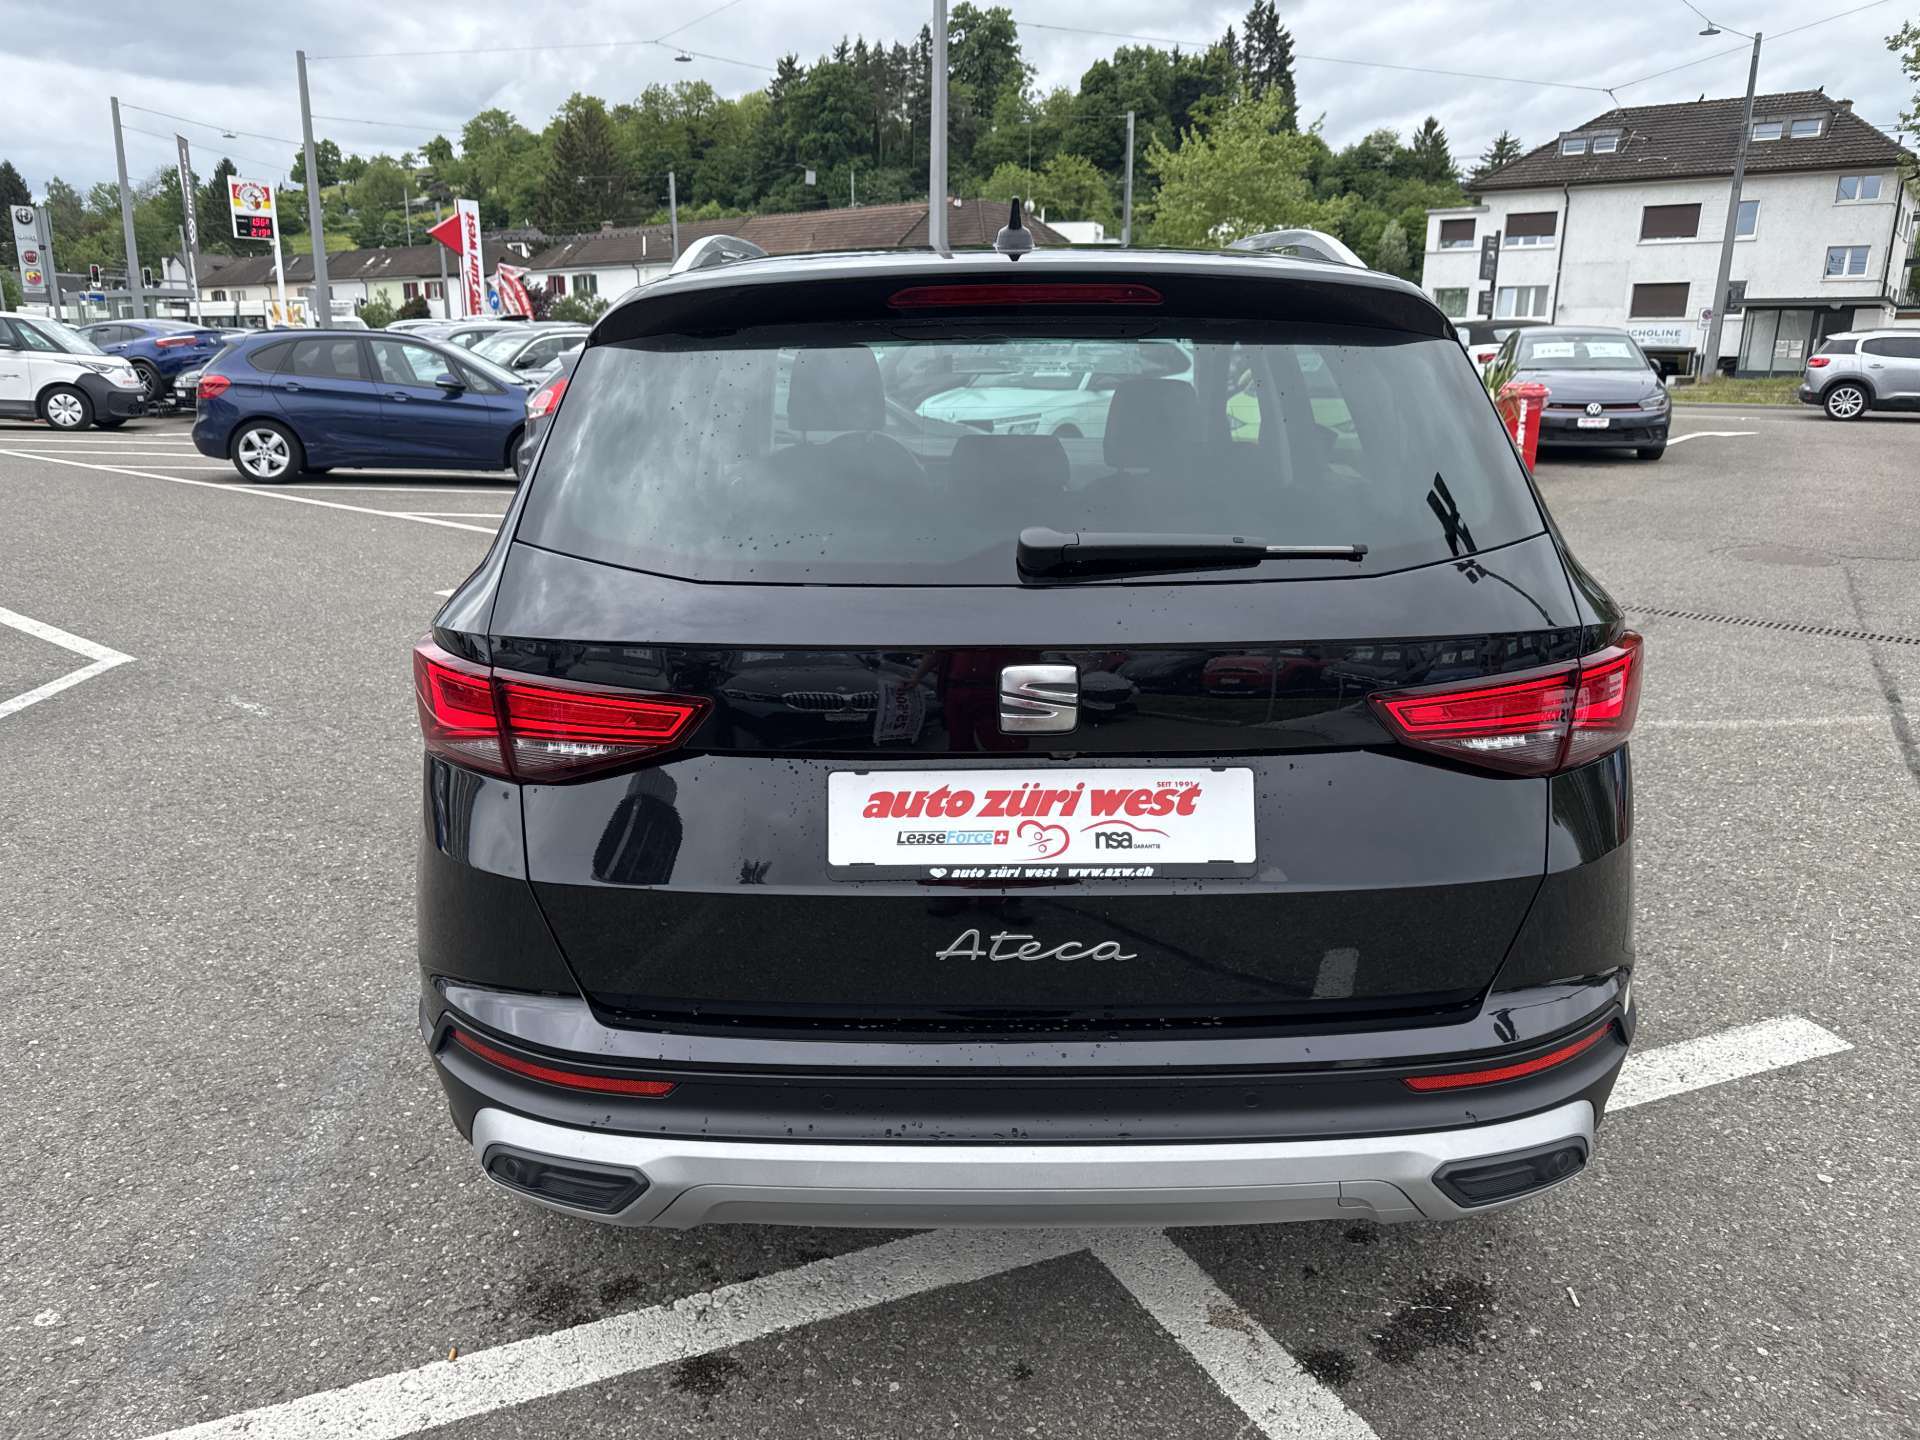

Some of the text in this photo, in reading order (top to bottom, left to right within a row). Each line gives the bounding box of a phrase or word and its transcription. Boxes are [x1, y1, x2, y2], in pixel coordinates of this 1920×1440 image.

[1626, 329, 1682, 337] CHOLINE
[862, 782, 1202, 818] auto züri west
[896, 831, 993, 845] LeaseForce
[1095, 831, 1133, 849] nsa
[951, 866, 1155, 878] auto züri west www.azw.ch
[935, 928, 1138, 961] Ateca
